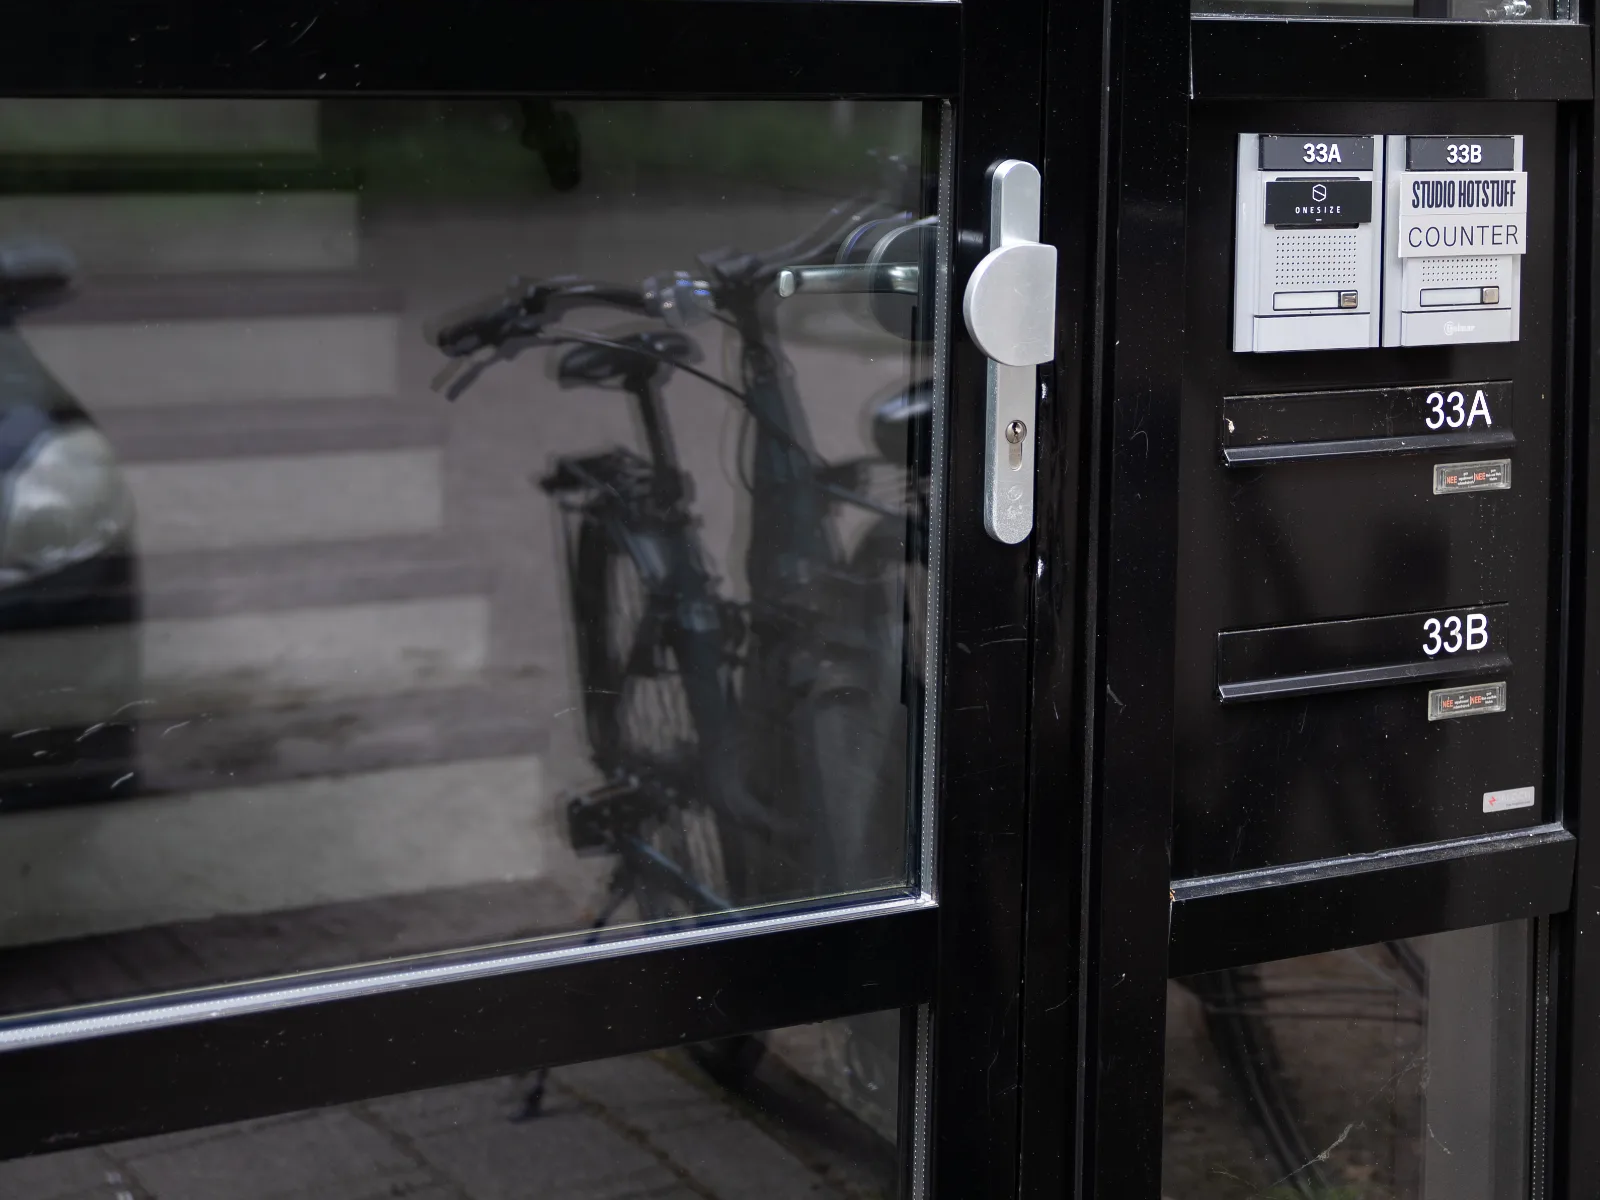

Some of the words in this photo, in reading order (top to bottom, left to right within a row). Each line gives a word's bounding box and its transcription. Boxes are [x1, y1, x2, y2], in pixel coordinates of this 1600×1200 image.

[1302, 143, 1342, 164] 33A
[1446, 144, 1483, 164] 33B
[1411, 180, 1455, 209] STUDIO
[1458, 179, 1517, 208] HOTSTUFF
[1295, 205, 1341, 214] ONESIZE
[1408, 224, 1519, 248] COUNTER
[1425, 389, 1493, 430] 33A
[1422, 613, 1489, 656] 33B
